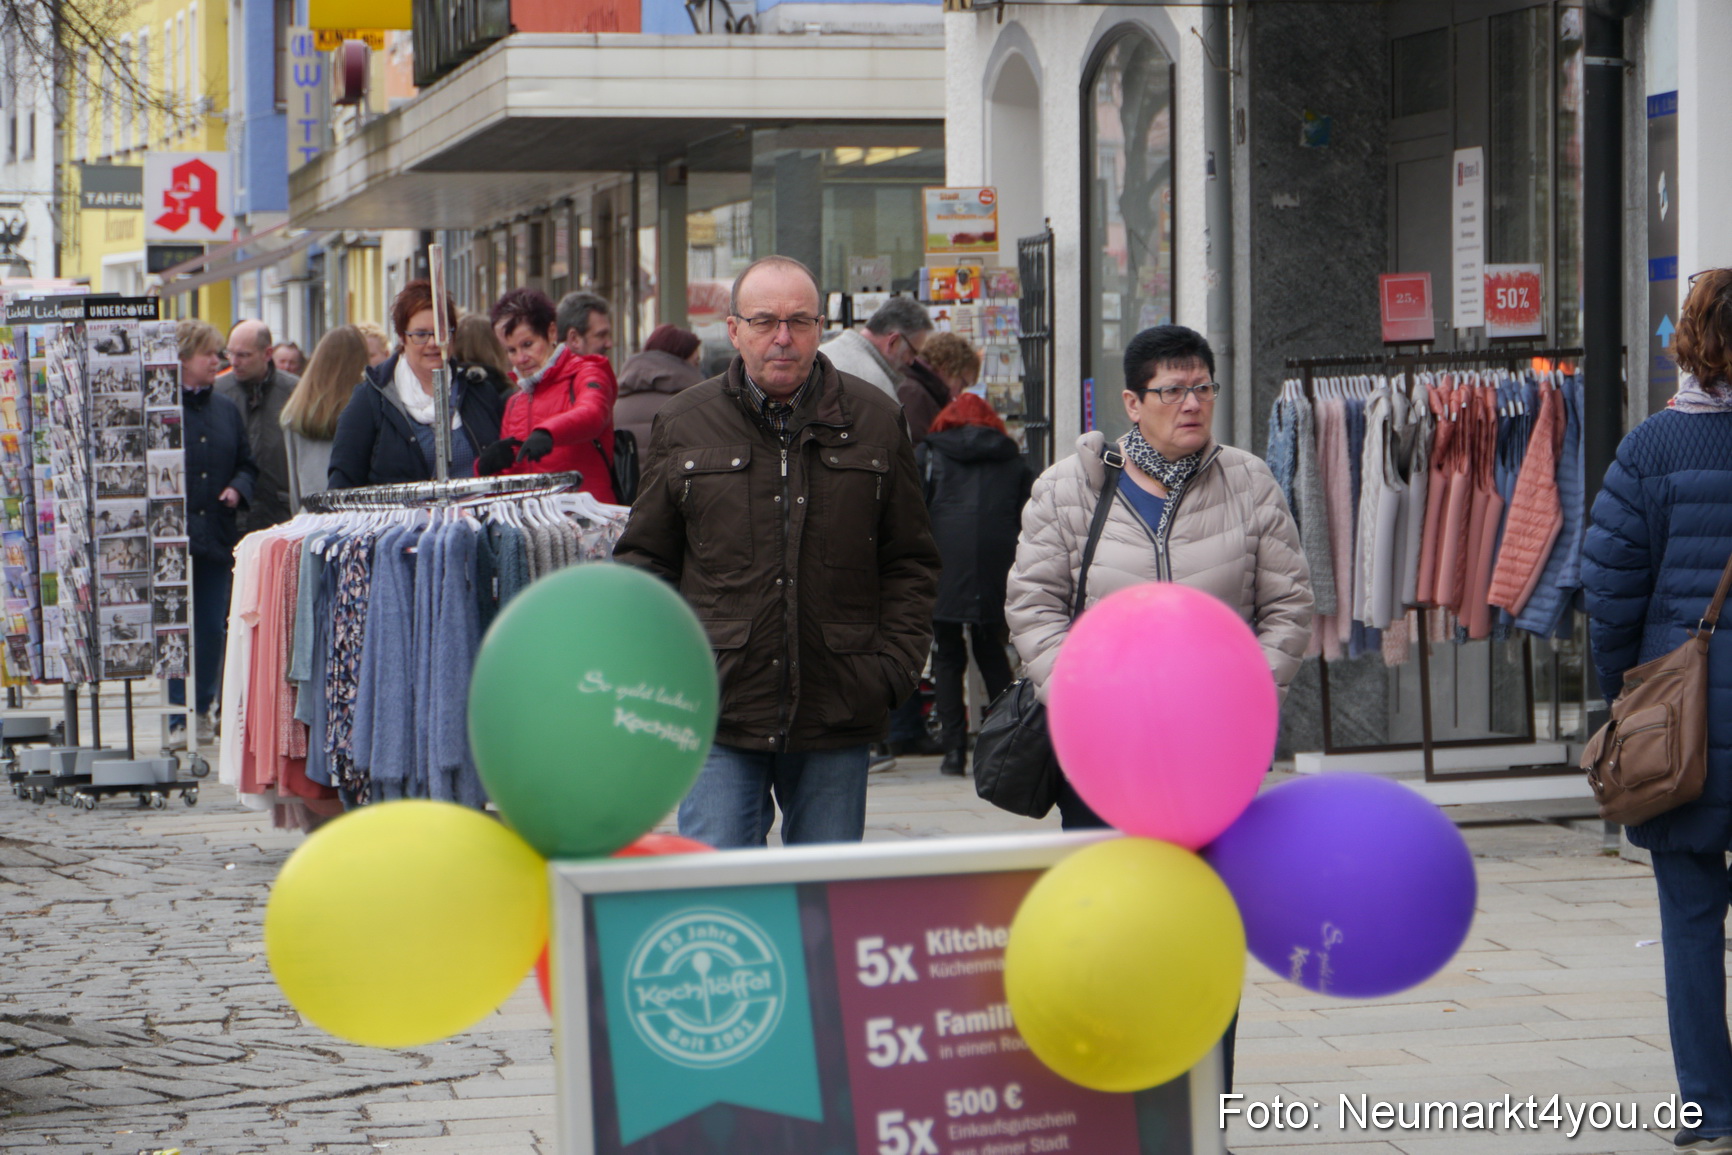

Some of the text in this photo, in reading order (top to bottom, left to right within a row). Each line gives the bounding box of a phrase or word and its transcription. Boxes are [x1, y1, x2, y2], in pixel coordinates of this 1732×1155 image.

[86, 191, 143, 205] TAIFUN
[89, 304, 155, 318] UNDERCOVER
[1496, 287, 1530, 309] 50%
[687, 923, 738, 946] Jahre
[925, 922, 1009, 957] Kitche
[855, 935, 919, 987] 5x
[929, 957, 1007, 979] Küchenma
[667, 1019, 755, 1051] Seit 1961
[935, 1003, 1016, 1037] Famili
[865, 1016, 929, 1068] 5x
[939, 1044, 954, 1060] in
[957, 1039, 997, 1058] einen
[945, 1082, 1024, 1117] 500 €
[876, 1110, 940, 1155] 5x
[948, 1110, 1077, 1141] Einkaufsgutschein
[1030, 1133, 1070, 1153] Stadt
